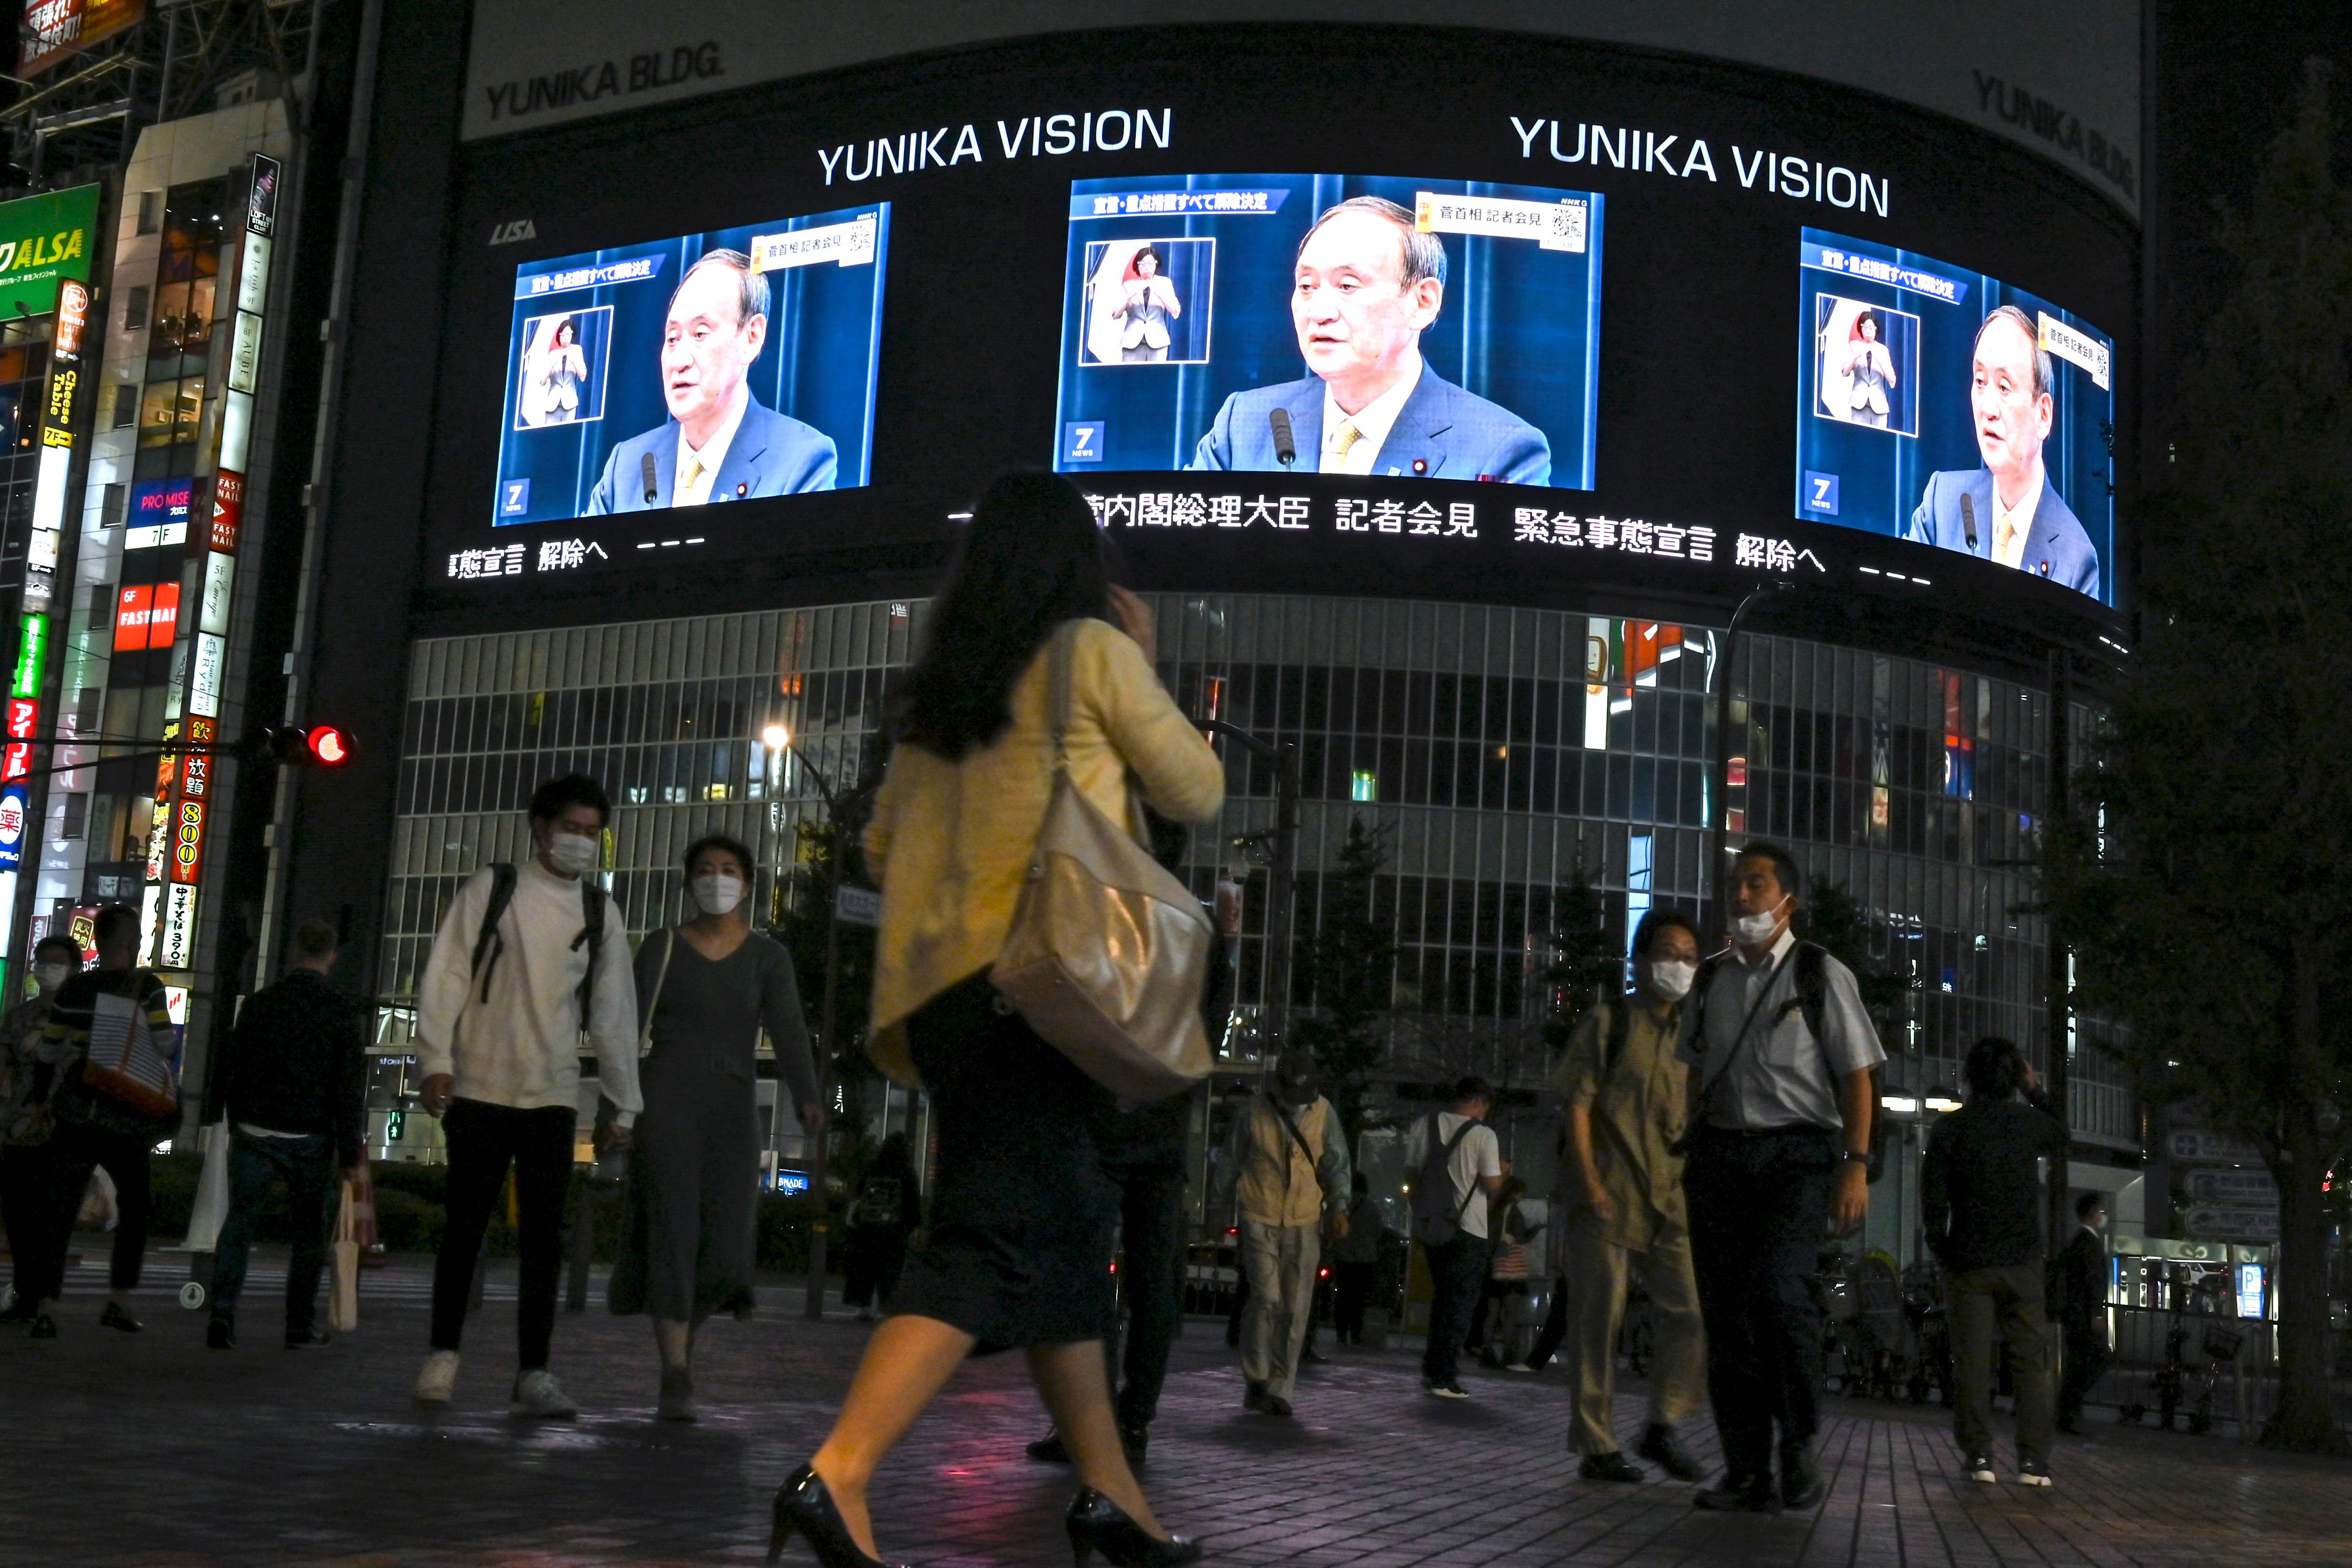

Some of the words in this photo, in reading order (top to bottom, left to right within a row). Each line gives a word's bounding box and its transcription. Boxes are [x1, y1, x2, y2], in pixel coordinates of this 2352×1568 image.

[487, 61, 620, 120] YUNIKA
[1971, 69, 2084, 160] YUNIKA
[818, 125, 982, 185] YUNIKA
[997, 108, 1171, 158] VISION
[1510, 117, 1717, 182] YUNIKA
[1732, 146, 1889, 218] VISION
[250, 210, 266, 220] LOFT
[252, 218, 270, 228] STREET
[1486, 209, 1542, 226] 記者会見
[247, 296, 256, 305] 9F
[243, 327, 253, 336] 8F
[51, 373, 65, 416] Table
[61, 370, 77, 425] Cheese
[46, 430, 60, 441] 7F
[1075, 428, 1094, 449] 7
[1071, 449, 1093, 457] NEWS
[219, 478, 242, 491] FAST
[1813, 479, 1830, 500] 7
[141, 491, 190, 510] PROMISE
[217, 488, 239, 501] NAIL
[508, 485, 523, 503] 7
[1812, 498, 1830, 509] NEWS
[214, 523, 236, 535] FAST
[1335, 498, 1478, 538] 記者会見
[1514, 507, 1716, 562] 緊急事態宣言
[1735, 532, 1825, 573] 解除へ
[212, 534, 234, 547] NAIL
[539, 538, 608, 572] 解除へ
[214, 565, 226, 575] 5F
[124, 590, 136, 603] 6F
[196, 658, 210, 710] Rydia
[185, 720, 211, 796] 飲放題
[0, 809, 21, 833] 薬
[2245, 1271, 2253, 1289] P
